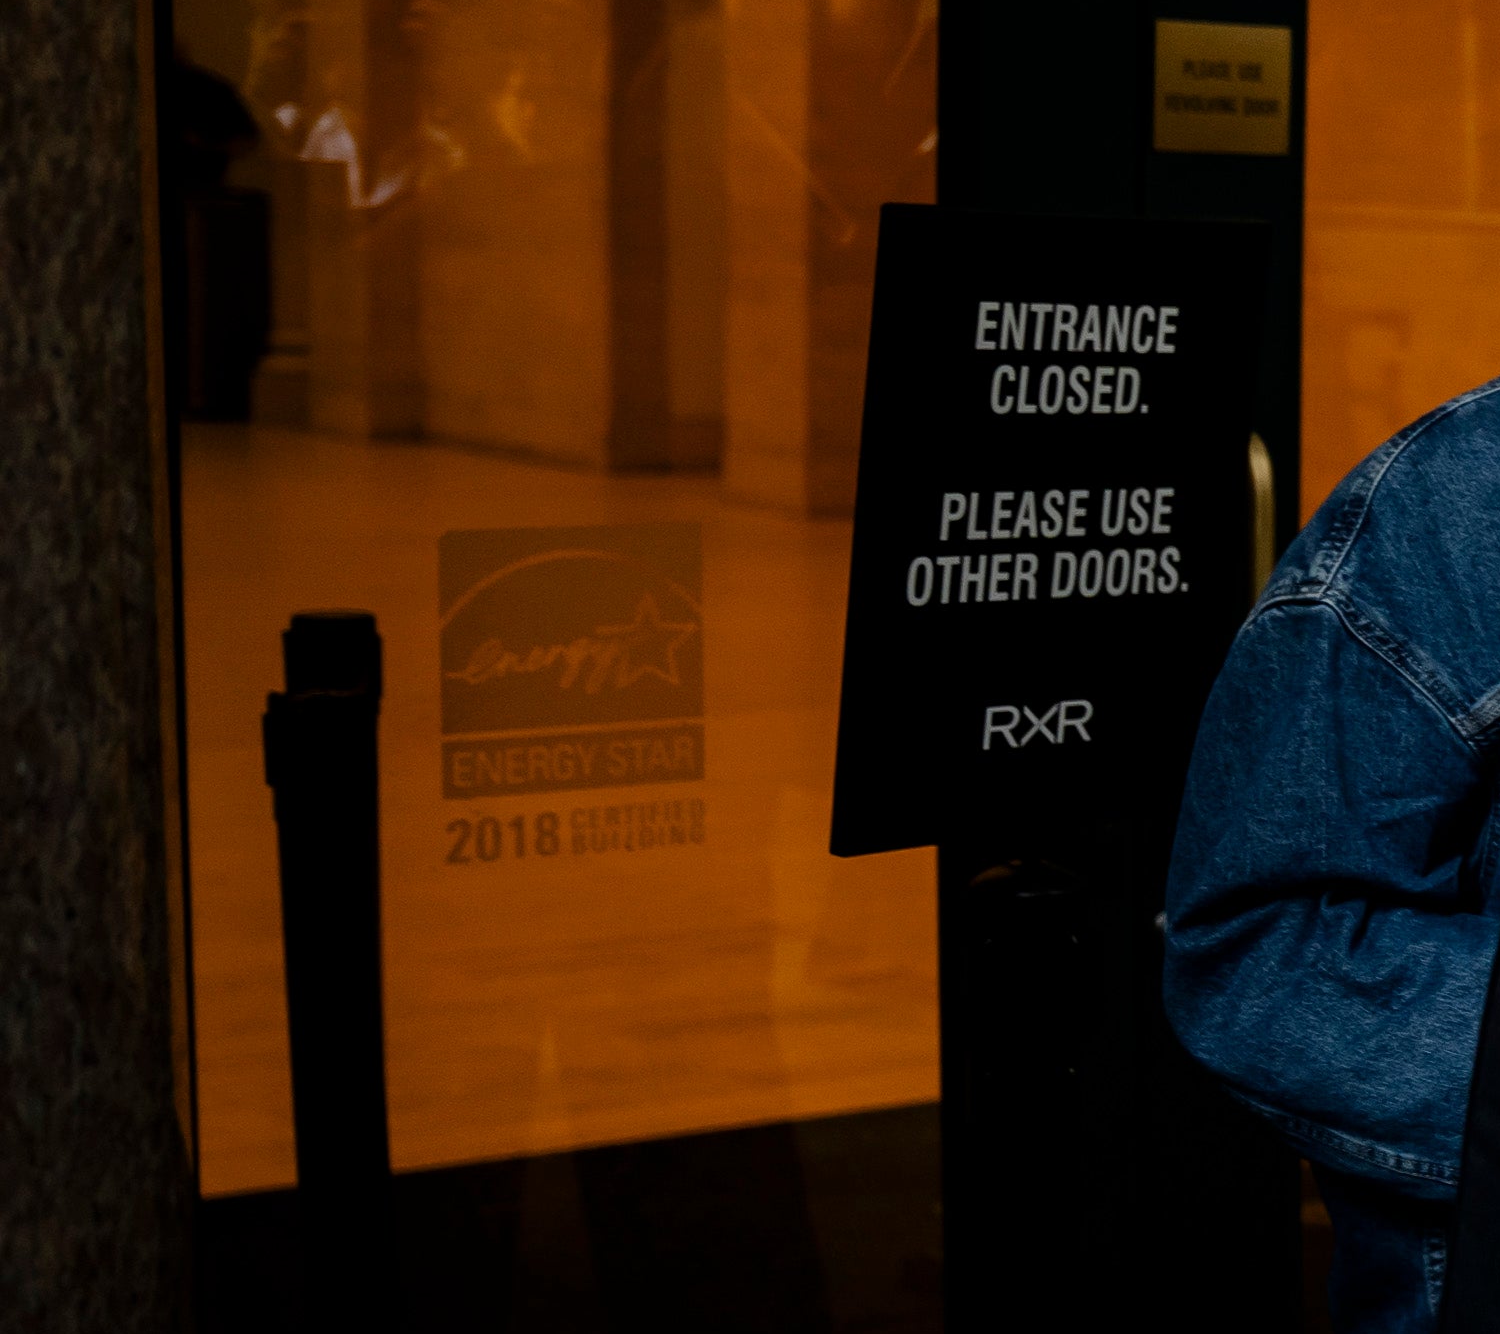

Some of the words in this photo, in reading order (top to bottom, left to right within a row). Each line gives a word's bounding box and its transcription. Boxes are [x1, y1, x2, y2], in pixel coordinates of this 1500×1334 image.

[974, 301, 1179, 354] ENTRANCE
[990, 365, 1149, 415] CLOSED.
[940, 489, 1090, 541] PLEASE
[1101, 487, 1175, 534] USE
[906, 553, 1038, 607] OTHER
[1051, 546, 1190, 599] DOORS.
[982, 699, 1094, 751] RXR
[451, 743, 597, 788] ENERGY
[607, 734, 696, 776] STAR
[445, 810, 561, 866] 2018
[569, 798, 706, 830] CERTIFIED
